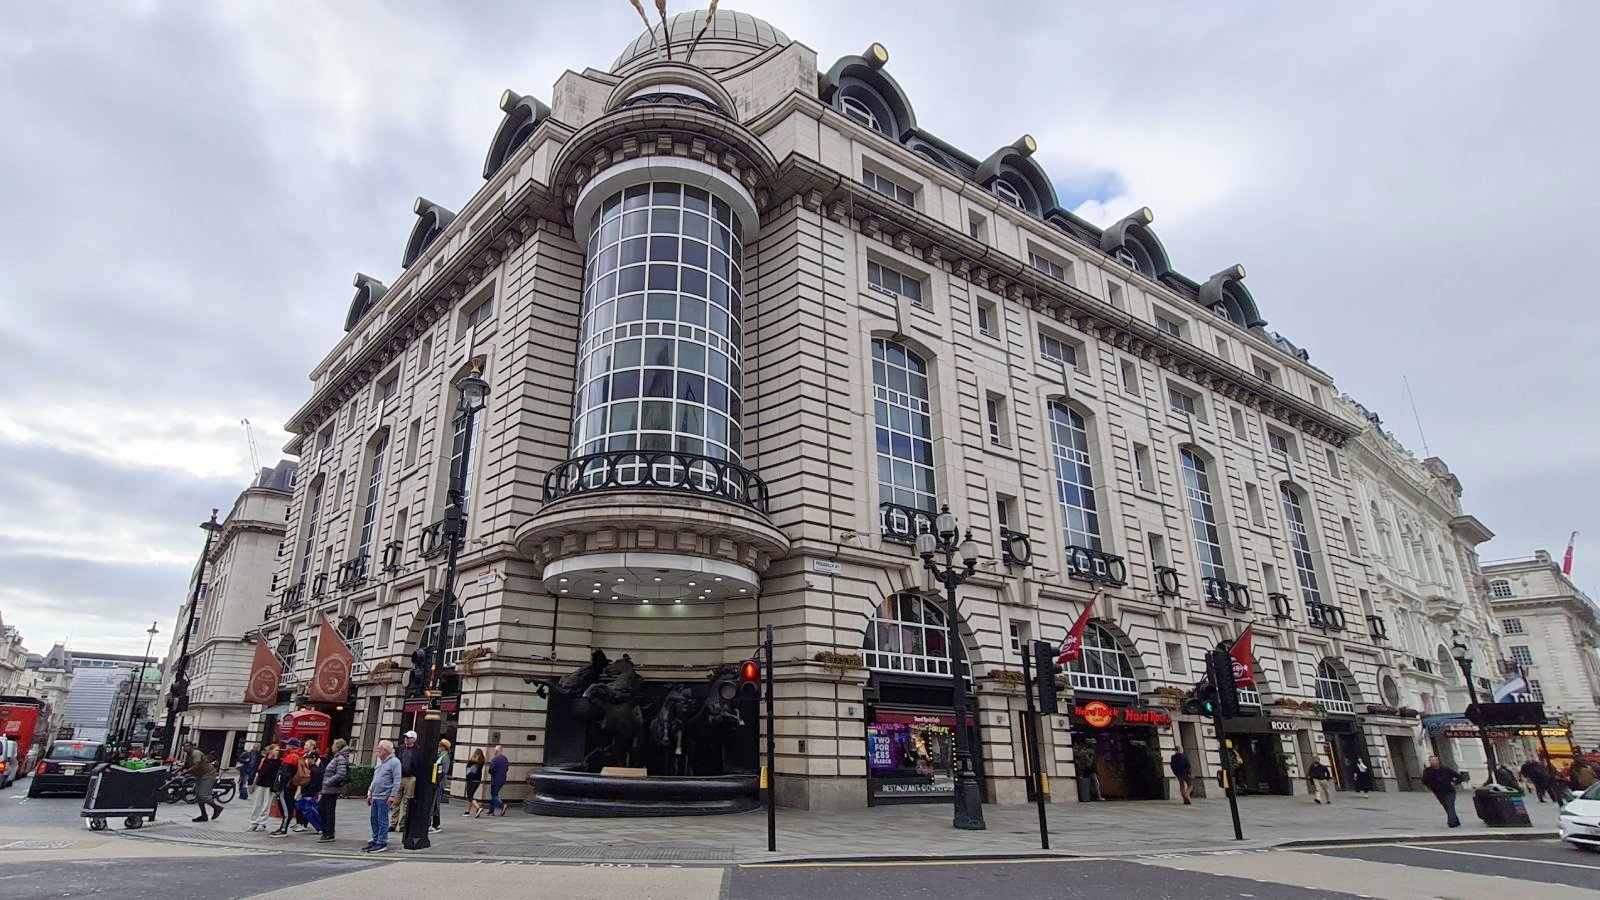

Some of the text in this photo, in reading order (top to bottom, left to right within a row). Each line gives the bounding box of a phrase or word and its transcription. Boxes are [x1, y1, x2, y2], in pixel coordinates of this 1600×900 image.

[1126, 709, 1149, 721] Hard
[1271, 721, 1290, 730] ROCK
[873, 736, 890, 744] TWO
